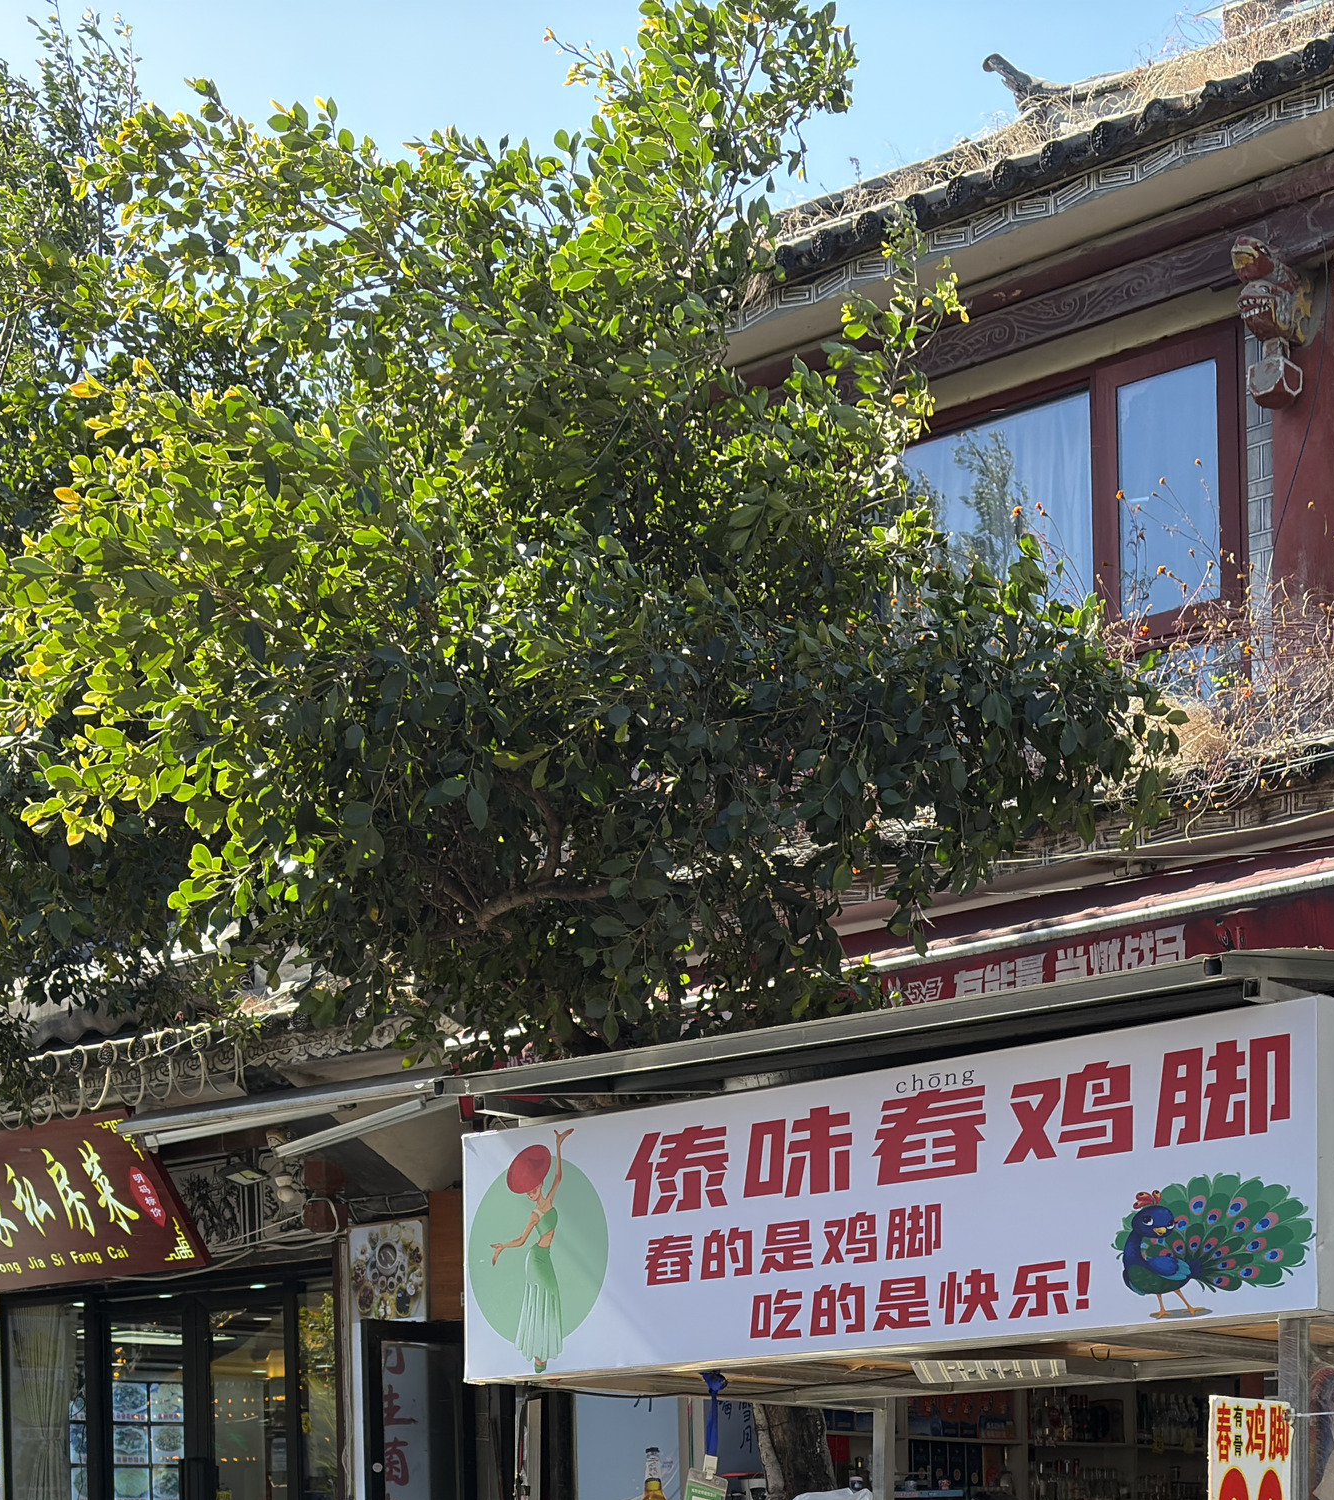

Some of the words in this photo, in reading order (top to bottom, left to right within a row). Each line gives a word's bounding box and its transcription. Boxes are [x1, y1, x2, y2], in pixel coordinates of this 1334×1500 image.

[895, 1069, 976, 1094] chōng
[625, 1032, 1292, 1215] 傣味舂鸡脚
[132, 1173, 163, 1217] 明码标价
[28, 1255, 46, 1270] Jia
[53, 1253, 65, 1267] Si
[70, 1250, 103, 1266] Fang
[107, 1245, 129, 1259] Cai
[644, 1203, 942, 1286] 舂的是鸡脚
